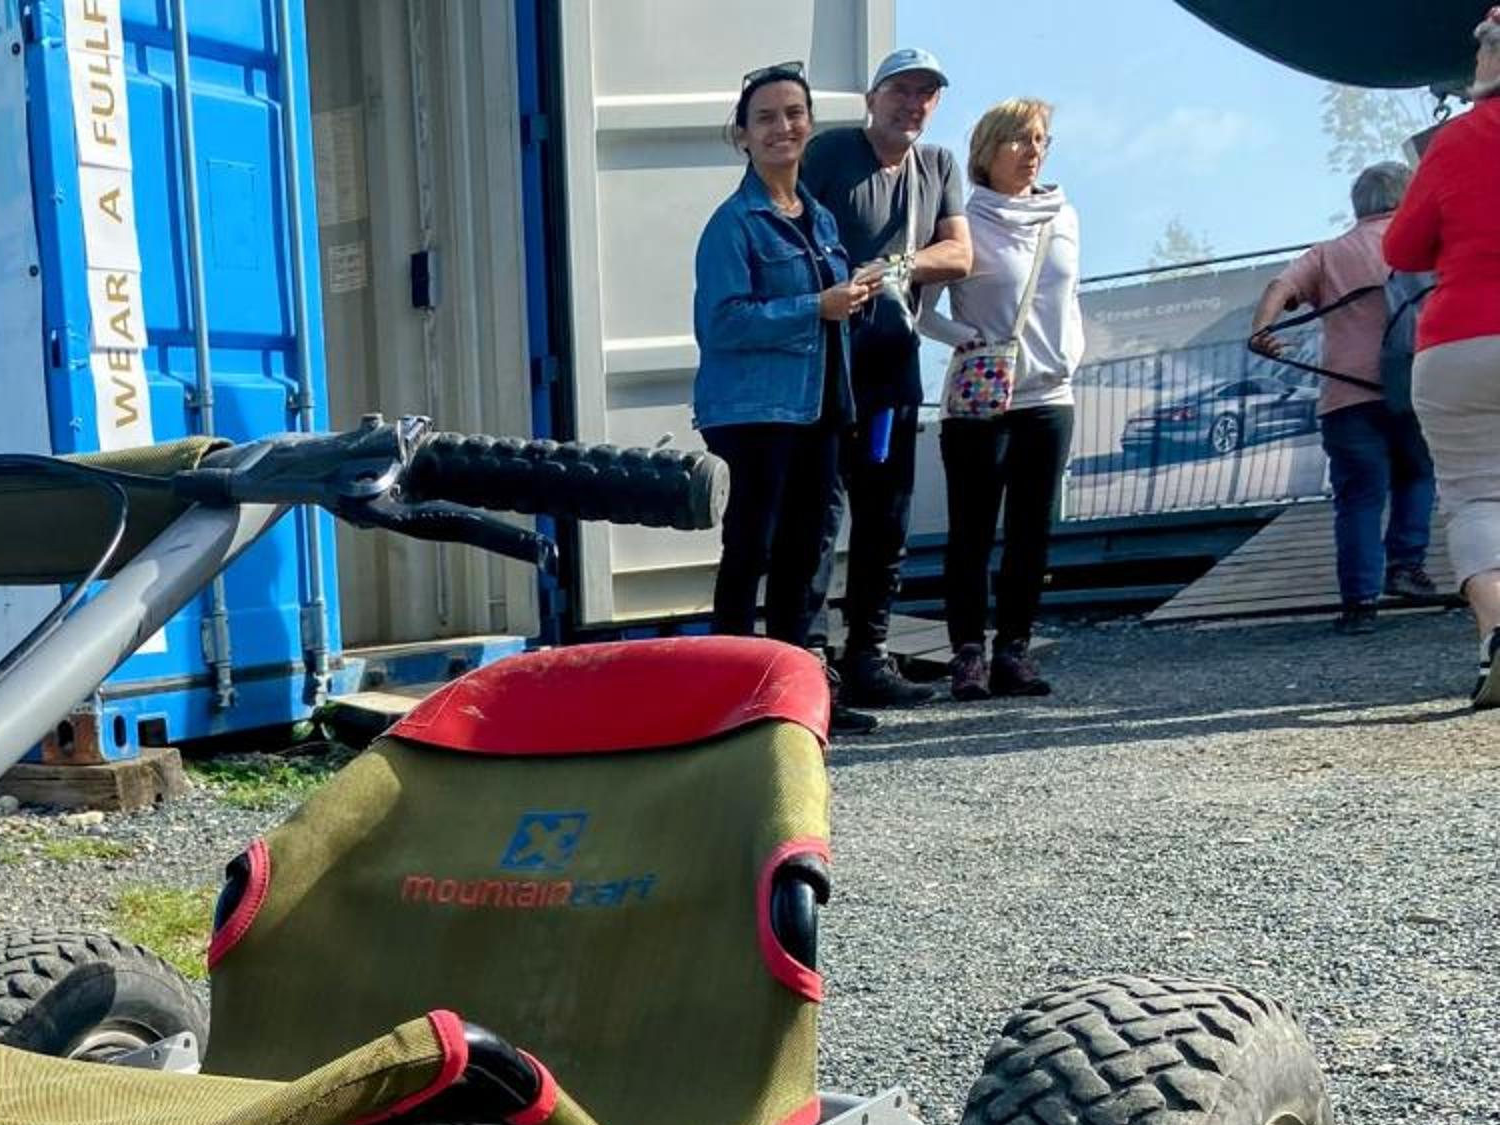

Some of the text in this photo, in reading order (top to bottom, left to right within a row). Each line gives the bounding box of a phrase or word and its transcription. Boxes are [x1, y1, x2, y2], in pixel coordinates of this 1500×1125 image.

[99, 187, 123, 224] A
[105, 273, 139, 428] WEAR
[402, 866, 659, 909] mountaincart
